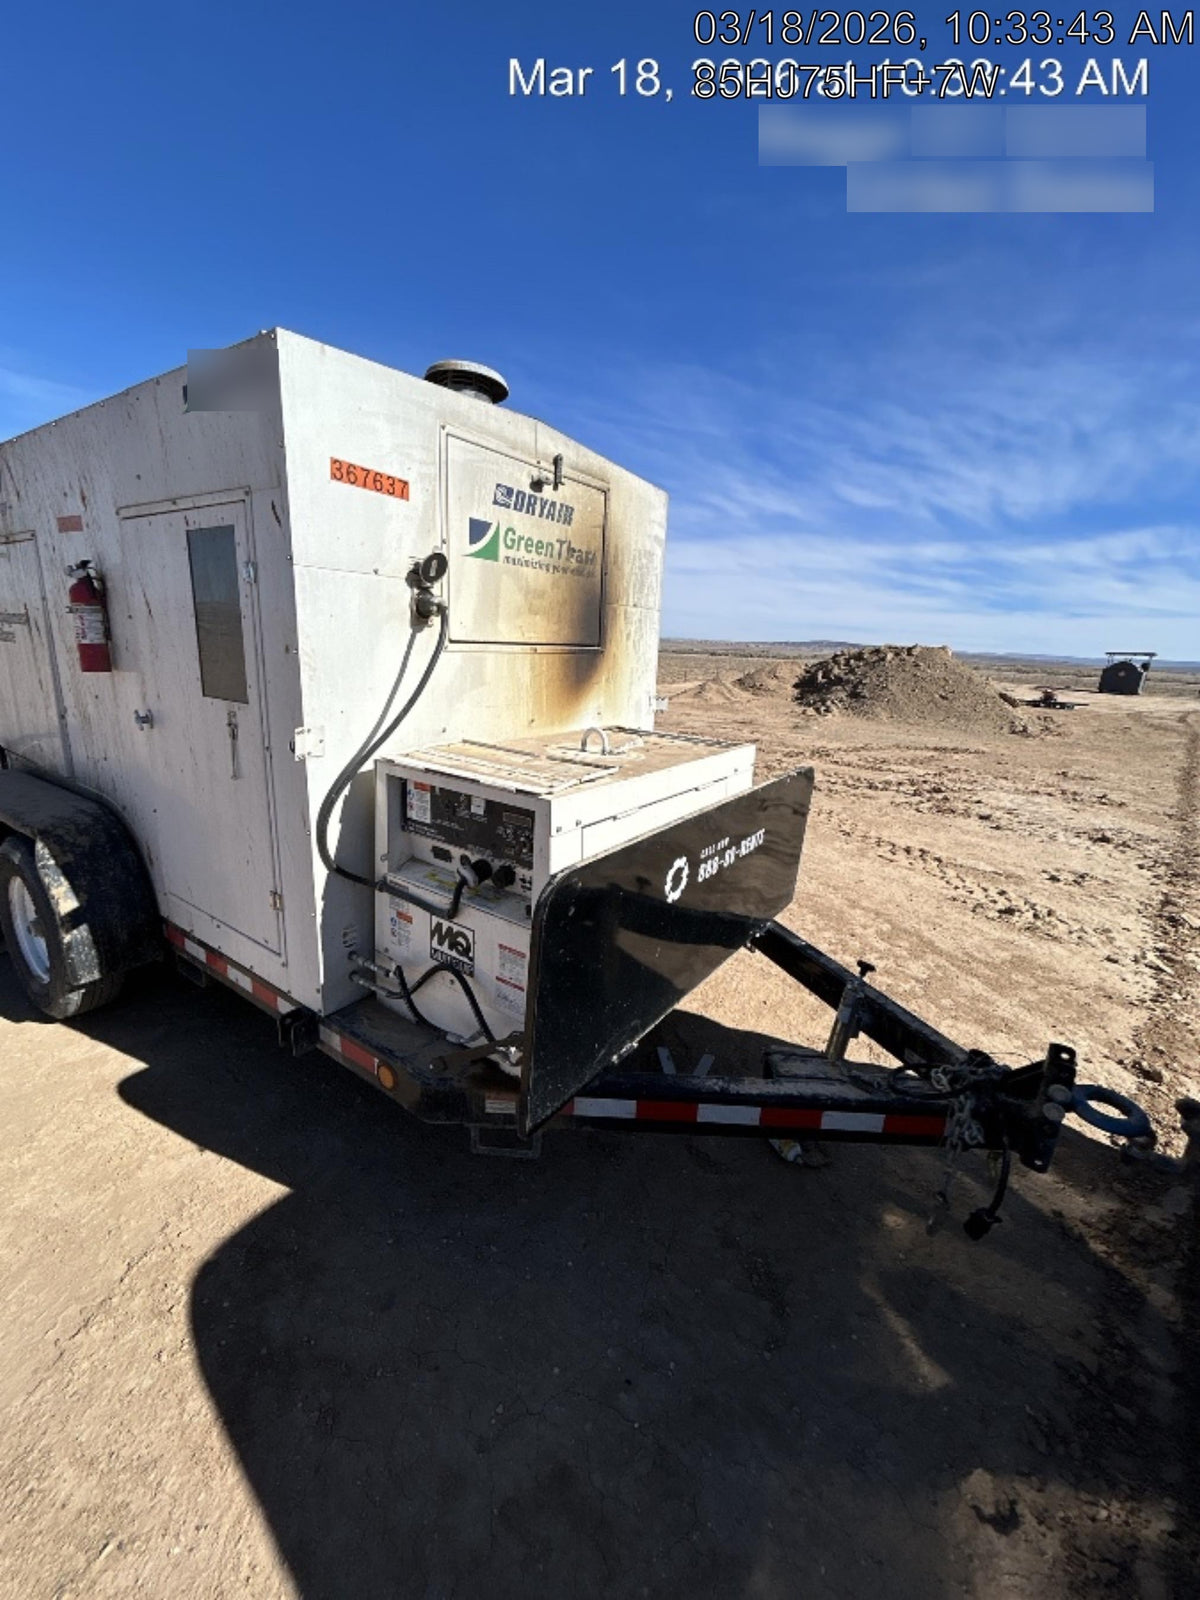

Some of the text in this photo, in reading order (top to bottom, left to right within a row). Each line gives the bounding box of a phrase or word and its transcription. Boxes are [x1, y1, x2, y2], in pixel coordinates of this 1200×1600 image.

[333, 459, 409, 499] 367637
[513, 489, 574, 526] DRYAIR
[430, 920, 472, 960] MQ
